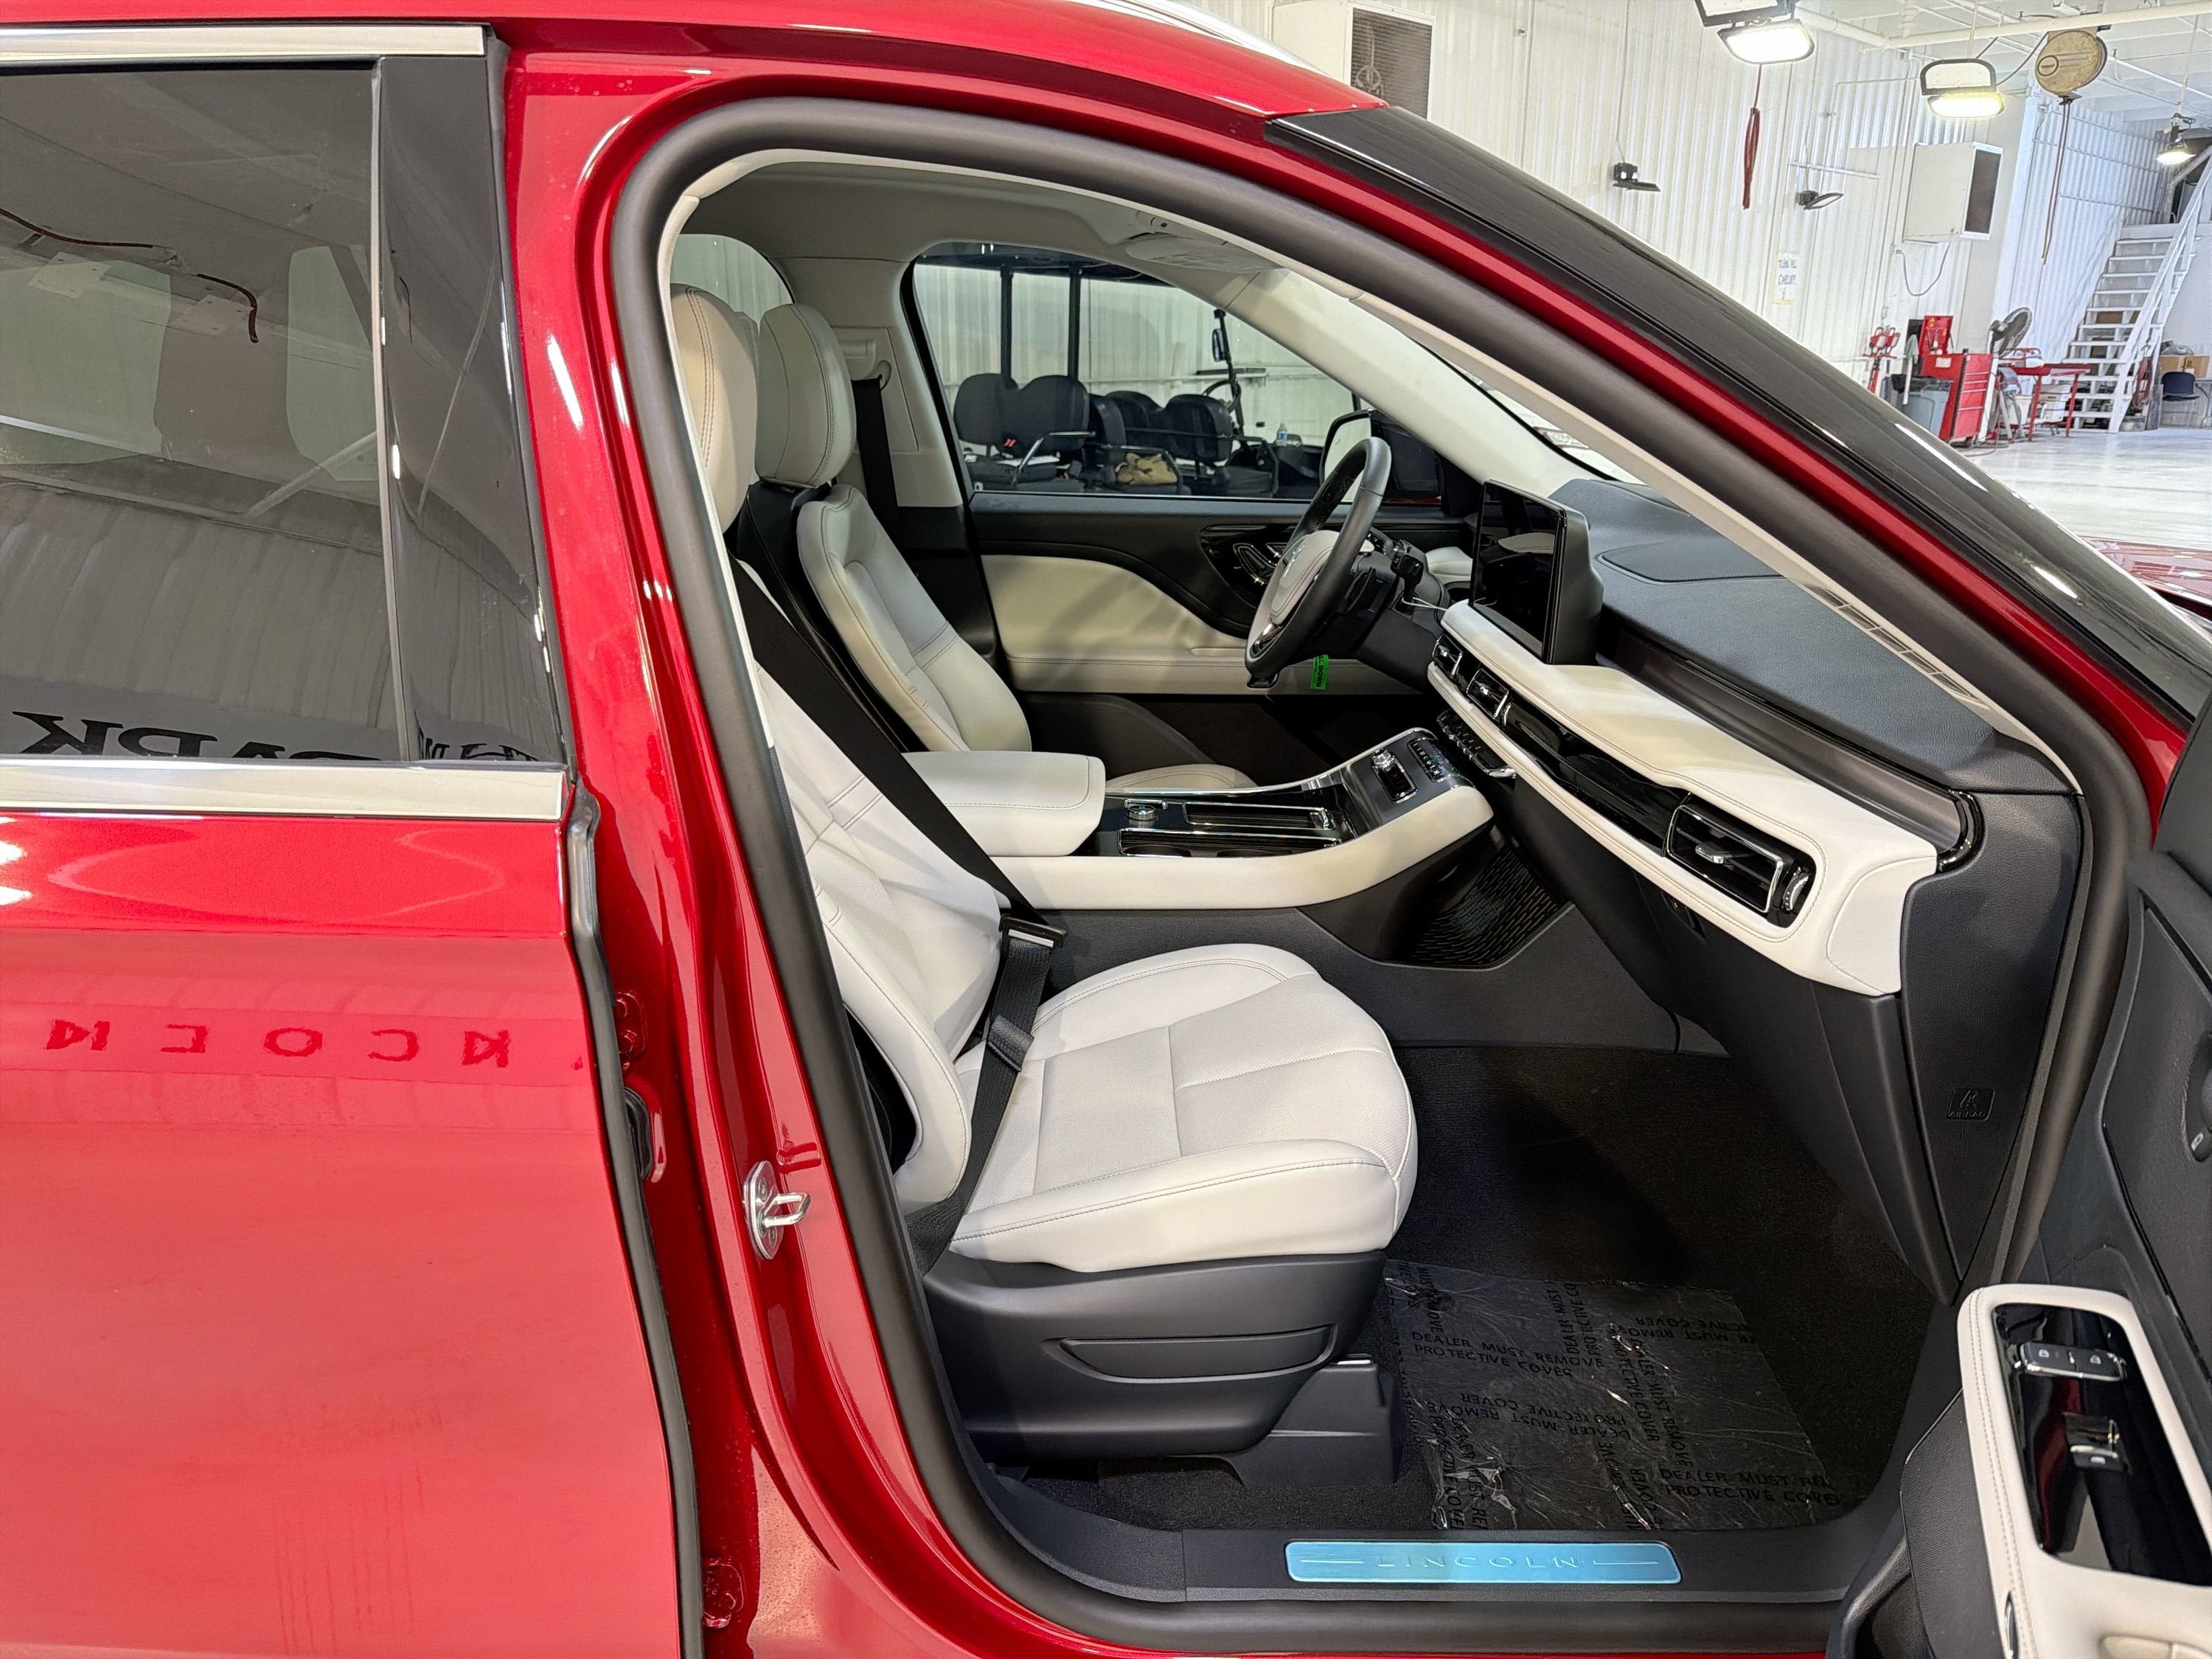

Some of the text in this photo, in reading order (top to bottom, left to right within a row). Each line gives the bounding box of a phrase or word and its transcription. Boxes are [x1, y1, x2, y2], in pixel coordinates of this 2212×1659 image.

[1315, 665, 1324, 687] DOWN
[1635, 1317, 1689, 1327] COVER
[1685, 1331, 1728, 1341] MUST
[1412, 1332, 1605, 1369] DEALER MUST REMOVE
[1414, 1344, 1573, 1377] PROTECTIVE COVER
[1427, 1402, 1631, 1440] DEALER MUST REMOVE
[1461, 1393, 1626, 1427] PROTECTIVE COVER
[1634, 1402, 1660, 1441] COVER
[1647, 1383, 1671, 1413] MUST
[1661, 1418, 1693, 1467] REMOVE
[1659, 1468, 1728, 1482] DEALER
[1736, 1471, 1790, 1486] MUST
[1665, 1484, 1775, 1502] PROTECTIVE
[1376, 1555, 1580, 1569] LINCOLN
